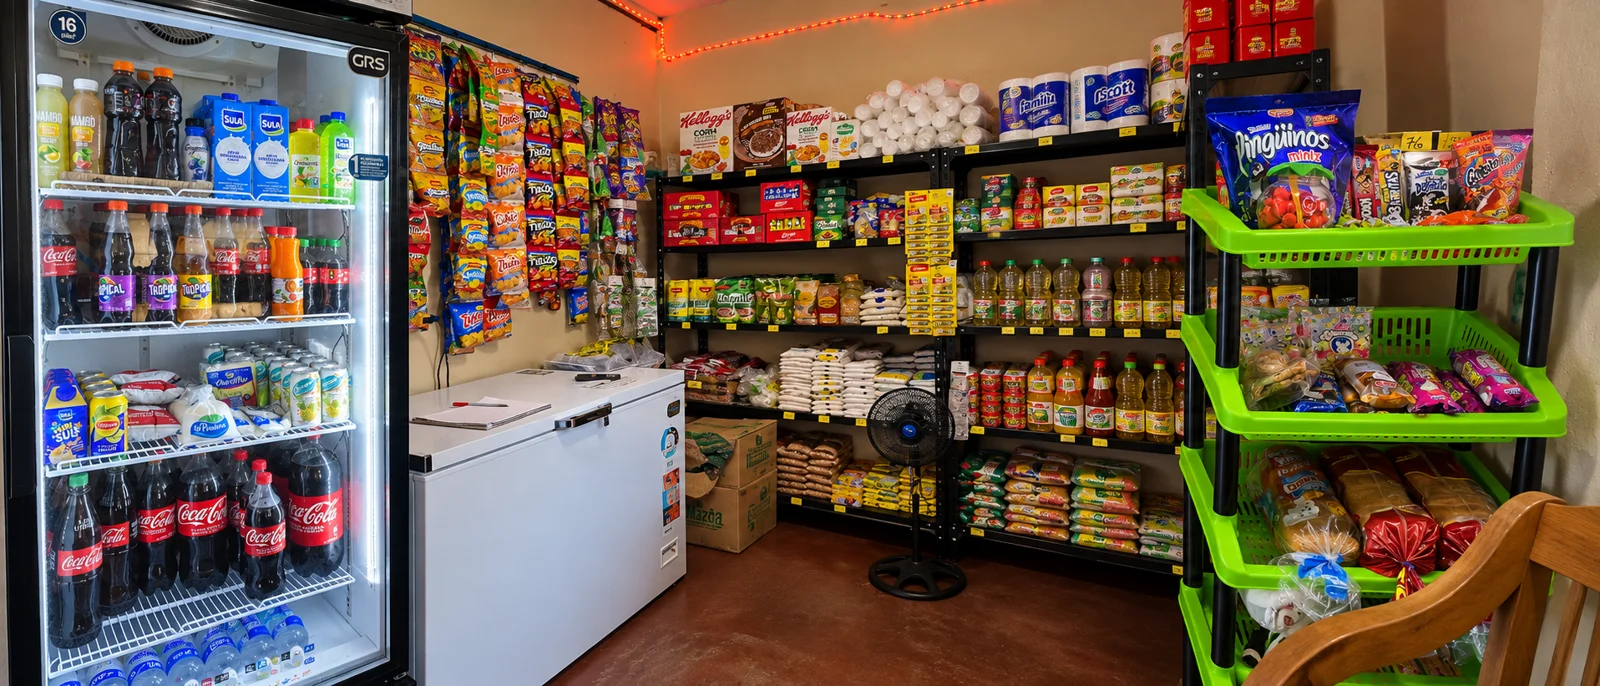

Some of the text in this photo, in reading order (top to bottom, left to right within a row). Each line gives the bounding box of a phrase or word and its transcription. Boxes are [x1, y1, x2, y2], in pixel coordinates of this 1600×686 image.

[58, 16, 77, 33] 16
[352, 53, 385, 71] GRS
[224, 115, 243, 125] SULA
[262, 120, 281, 129] SULA
[680, 109, 732, 128] Kellogg's
[787, 110, 830, 126] Kellogg's
[1235, 122, 1330, 178] Pingüinos
